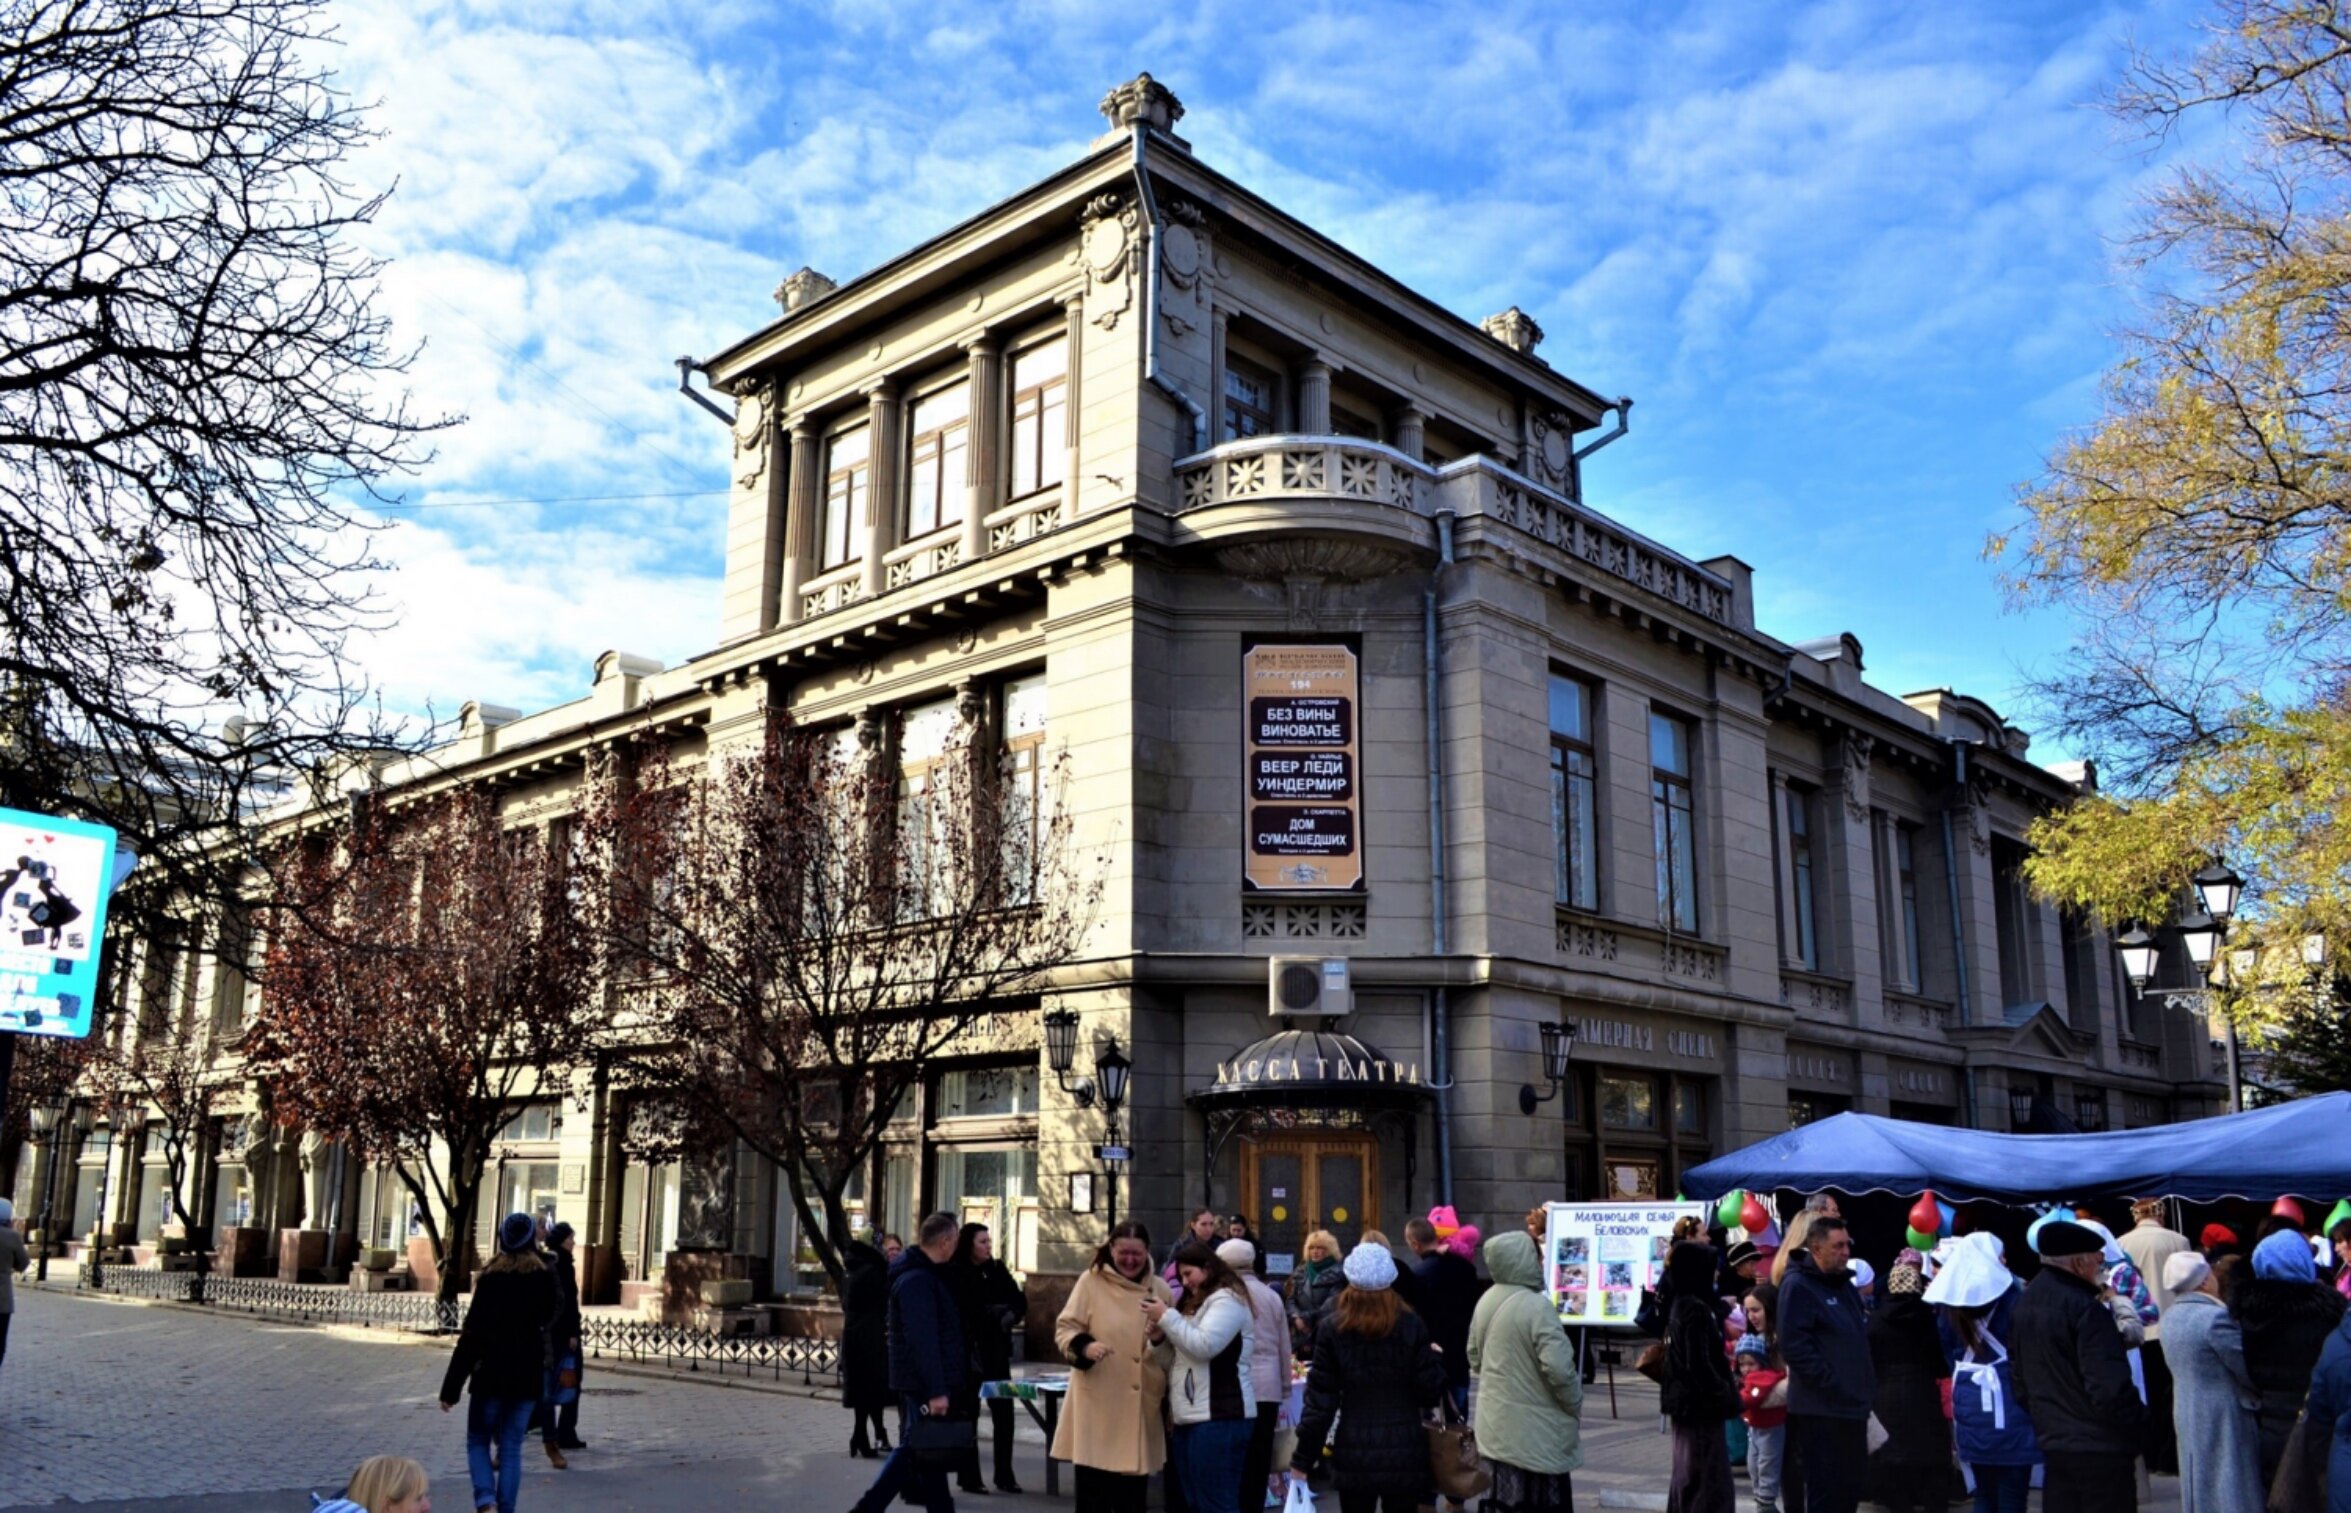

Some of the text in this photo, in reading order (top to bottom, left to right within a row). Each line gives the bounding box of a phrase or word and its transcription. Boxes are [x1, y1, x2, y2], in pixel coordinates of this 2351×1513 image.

[1267, 708, 1336, 721] БЕЗ ВИНЫ
[1261, 761, 1343, 776] ВЕЕР ЛЕДИ
[1257, 778, 1347, 792] УИНДЕРМИР
[1289, 818, 1315, 831] ДОМ
[1258, 832, 1347, 847] СУМАСШЕДШИХ
[1667, 1029, 1715, 1059] СЦЕНА
[1217, 1058, 1418, 1085] КАССА ТЕАТРА
